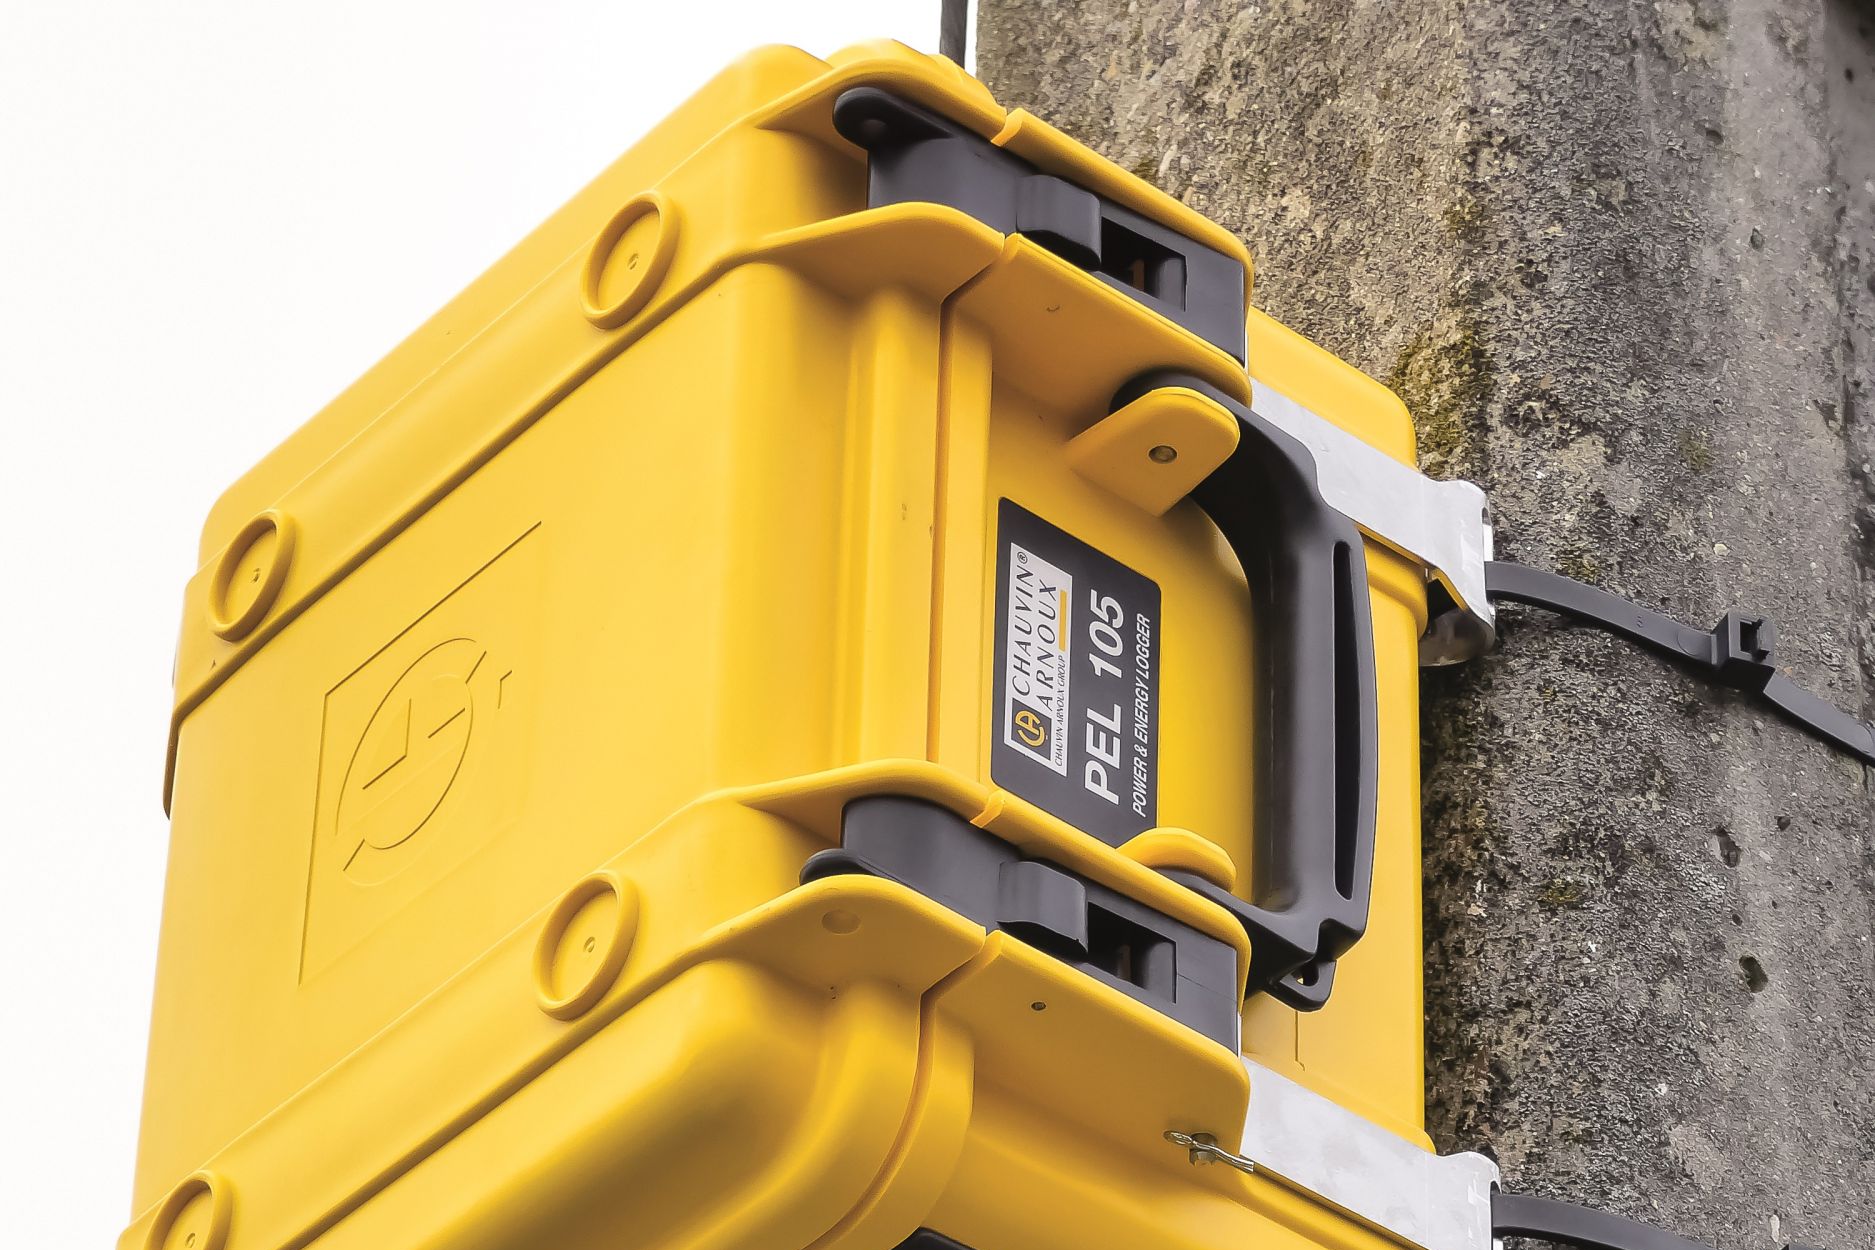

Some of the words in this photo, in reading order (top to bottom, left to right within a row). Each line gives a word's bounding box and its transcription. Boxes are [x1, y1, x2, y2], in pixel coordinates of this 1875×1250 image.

[1036, 579, 1056, 711] ARNOUX
[1088, 588, 1124, 678] 105
[1135, 613, 1151, 680] LOGGER
[1057, 655, 1066, 687] GROUP
[1056, 689, 1065, 726] ARNOUX
[1134, 676, 1149, 744] ENERGY
[1055, 726, 1063, 767] CHAUVIN
[1084, 703, 1122, 805] PEL
[1133, 743, 1148, 758] &
[1132, 756, 1148, 817] POWER
